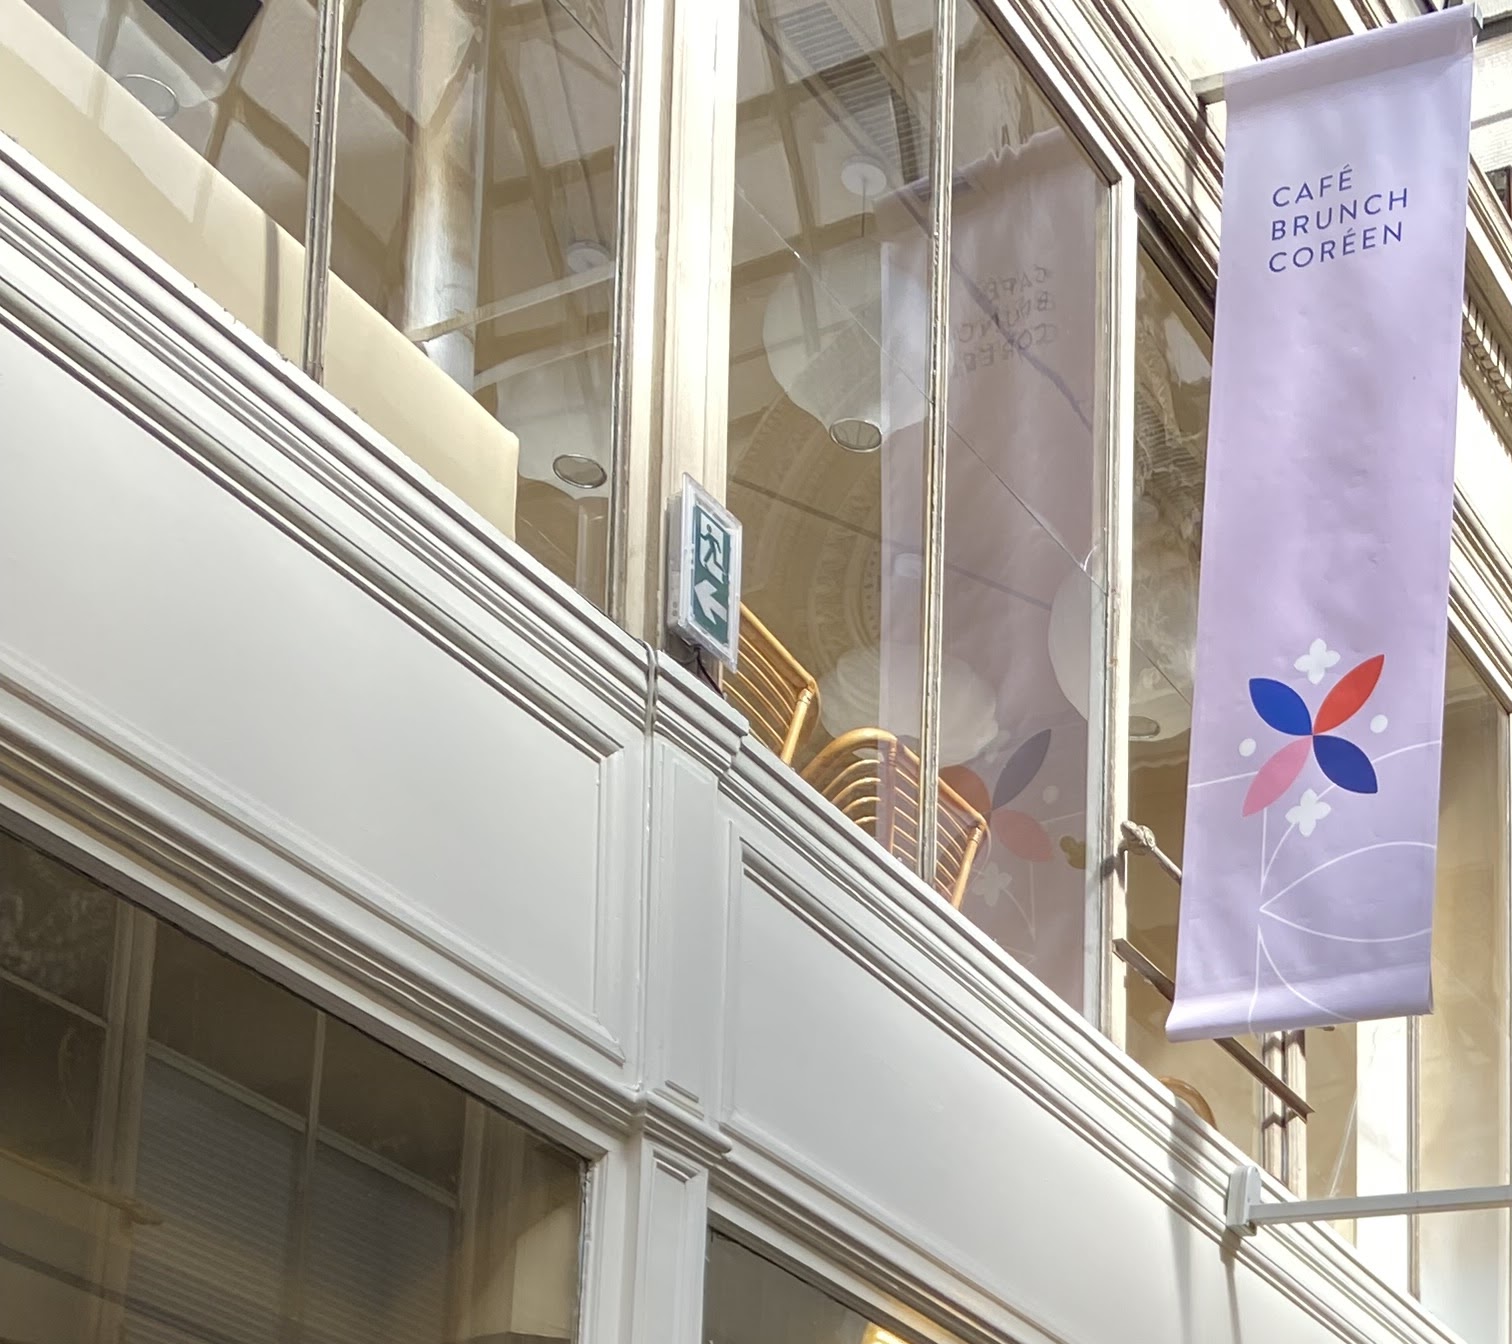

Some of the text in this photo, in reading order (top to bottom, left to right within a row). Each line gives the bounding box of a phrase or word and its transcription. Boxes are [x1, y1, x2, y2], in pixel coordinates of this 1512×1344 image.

[1272, 164, 1353, 208] CAFÉ
[1271, 187, 1408, 241] BRUNCH
[1268, 221, 1402, 273] CORÉEN
